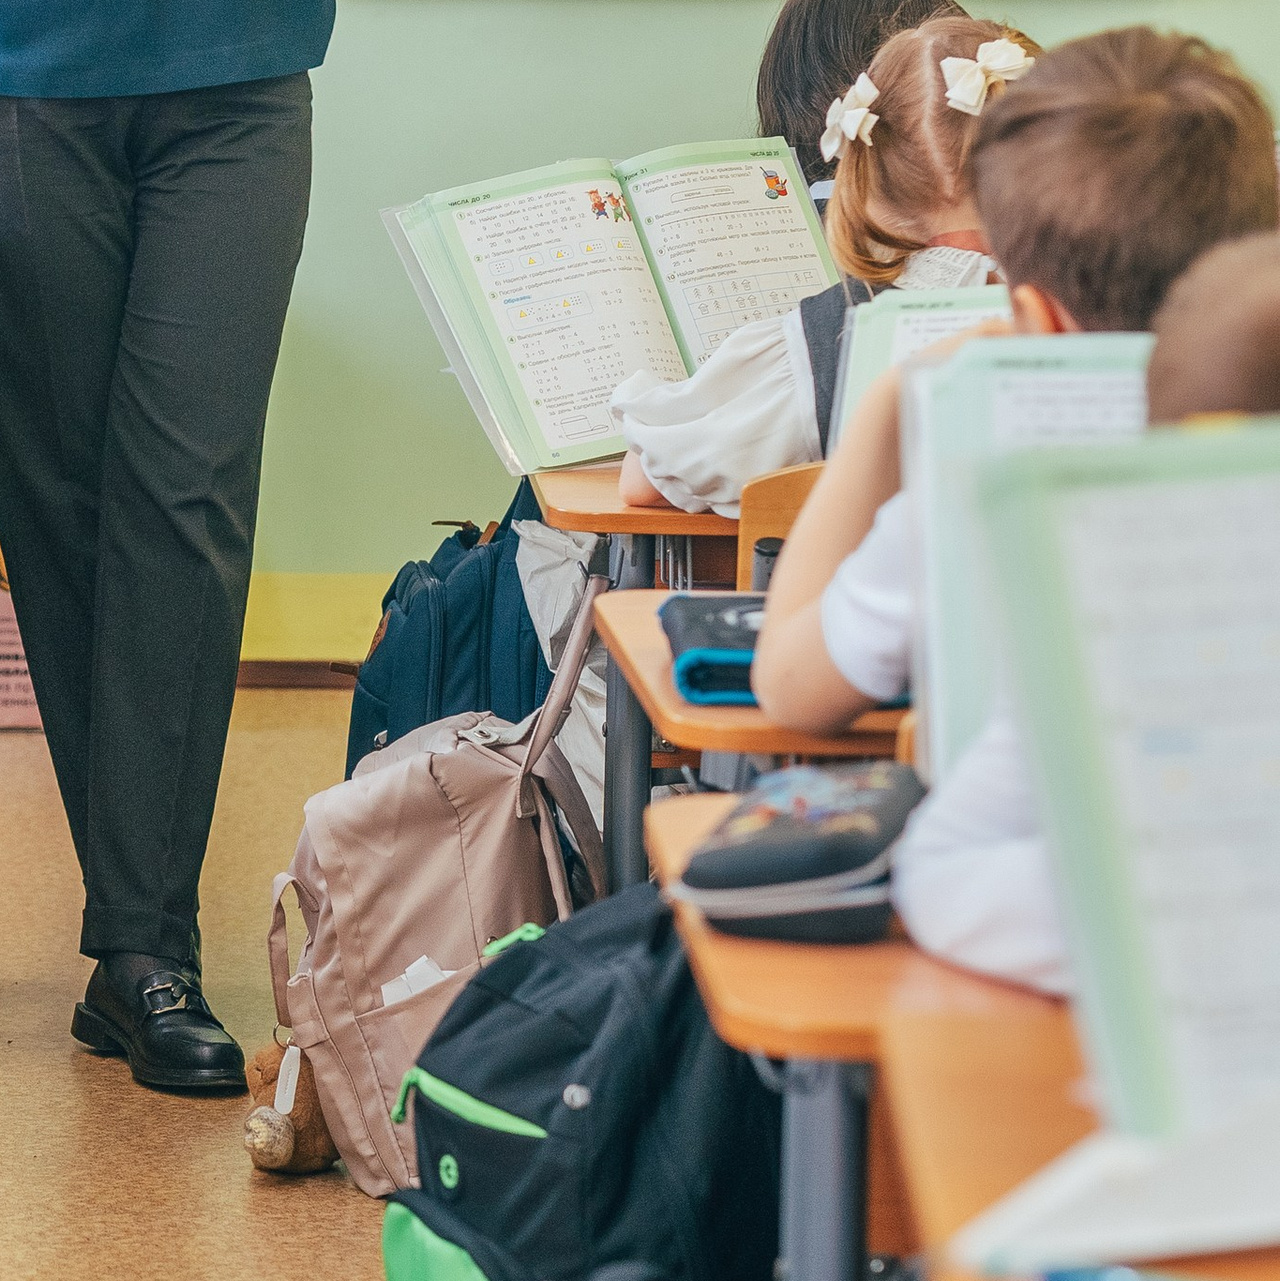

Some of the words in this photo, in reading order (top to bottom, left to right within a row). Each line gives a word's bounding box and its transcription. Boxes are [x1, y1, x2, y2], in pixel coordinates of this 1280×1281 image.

[624, 172, 638, 181] Урок
[643, 178, 664, 187] Купили
[448, 199, 469, 207] ЧИСЛА
[471, 196, 481, 204] ДО
[476, 204, 502, 215] Сосчитай
[479, 214, 497, 223] Найди
[499, 208, 521, 218] ошибки
[486, 230, 504, 239] Найди
[506, 225, 528, 235] ошибки
[492, 248, 515, 258] Запиши
[516, 242, 542, 252] цифрами
[667, 241, 697, 252] Используя
[503, 274, 527, 284] Нарисуй
[529, 266, 565, 278] графические
[567, 261, 588, 269] модели
[676, 270, 695, 278] Найди
[499, 286, 523, 296] Построй
[525, 277, 563, 289] графическую
[564, 273, 585, 281] модель
[587, 267, 611, 277] действия
[517, 332, 542, 340] Выполни
[528, 359, 549, 367] Сравни
[557, 350, 581, 361] обоснуй
[577, 385, 608, 396] наплакала
[545, 400, 575, 410] Несмеяна
[573, 400, 604, 411] Капризуля
